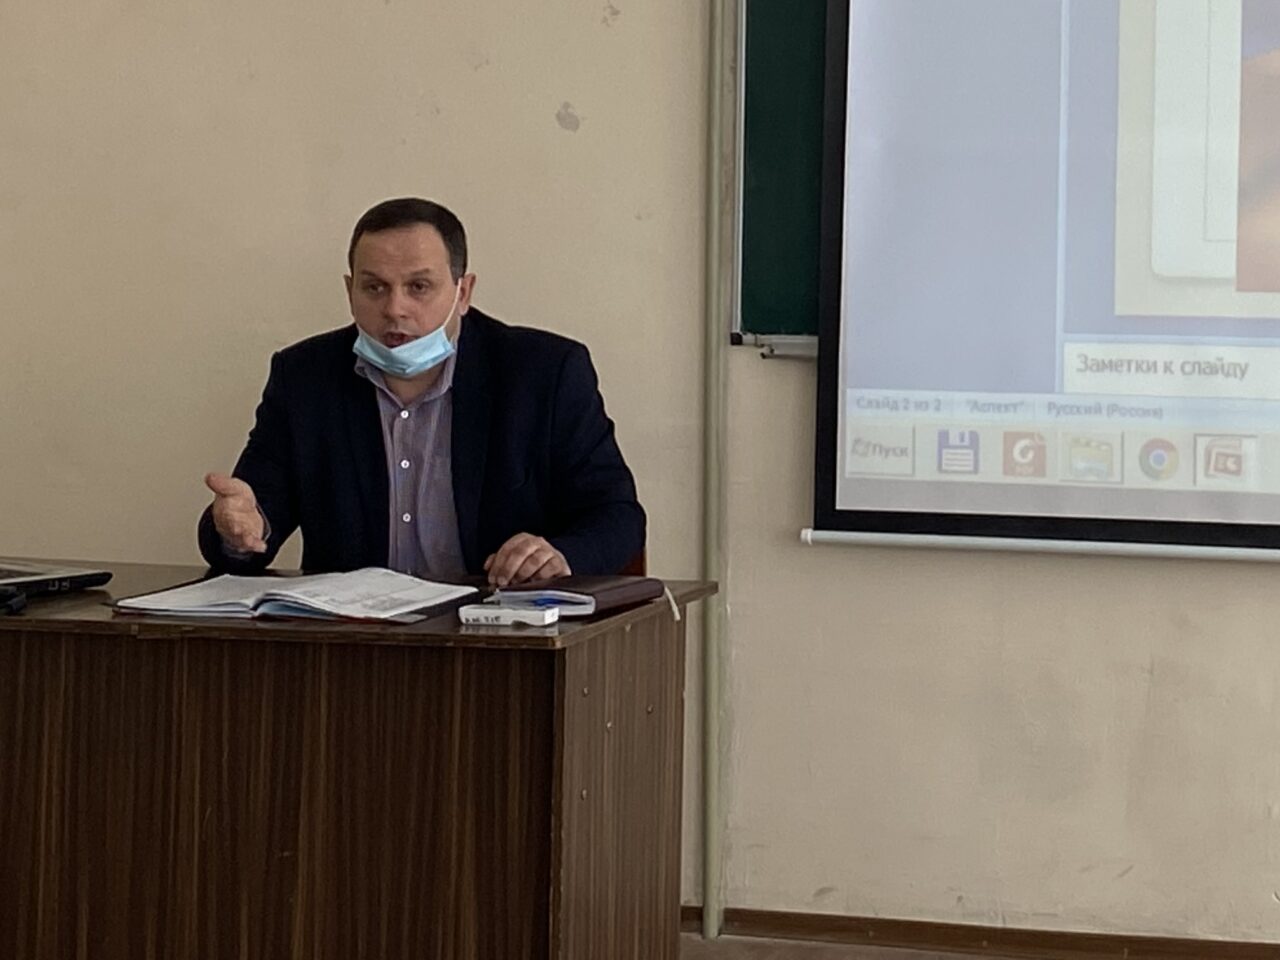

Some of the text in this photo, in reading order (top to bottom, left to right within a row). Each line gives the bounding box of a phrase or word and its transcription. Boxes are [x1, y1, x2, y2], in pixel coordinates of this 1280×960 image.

[1075, 353, 1250, 379] Заметки к слайду
[855, 396, 900, 413] Слайд
[1046, 402, 1102, 419] Русский
[872, 443, 909, 459] Пуск
